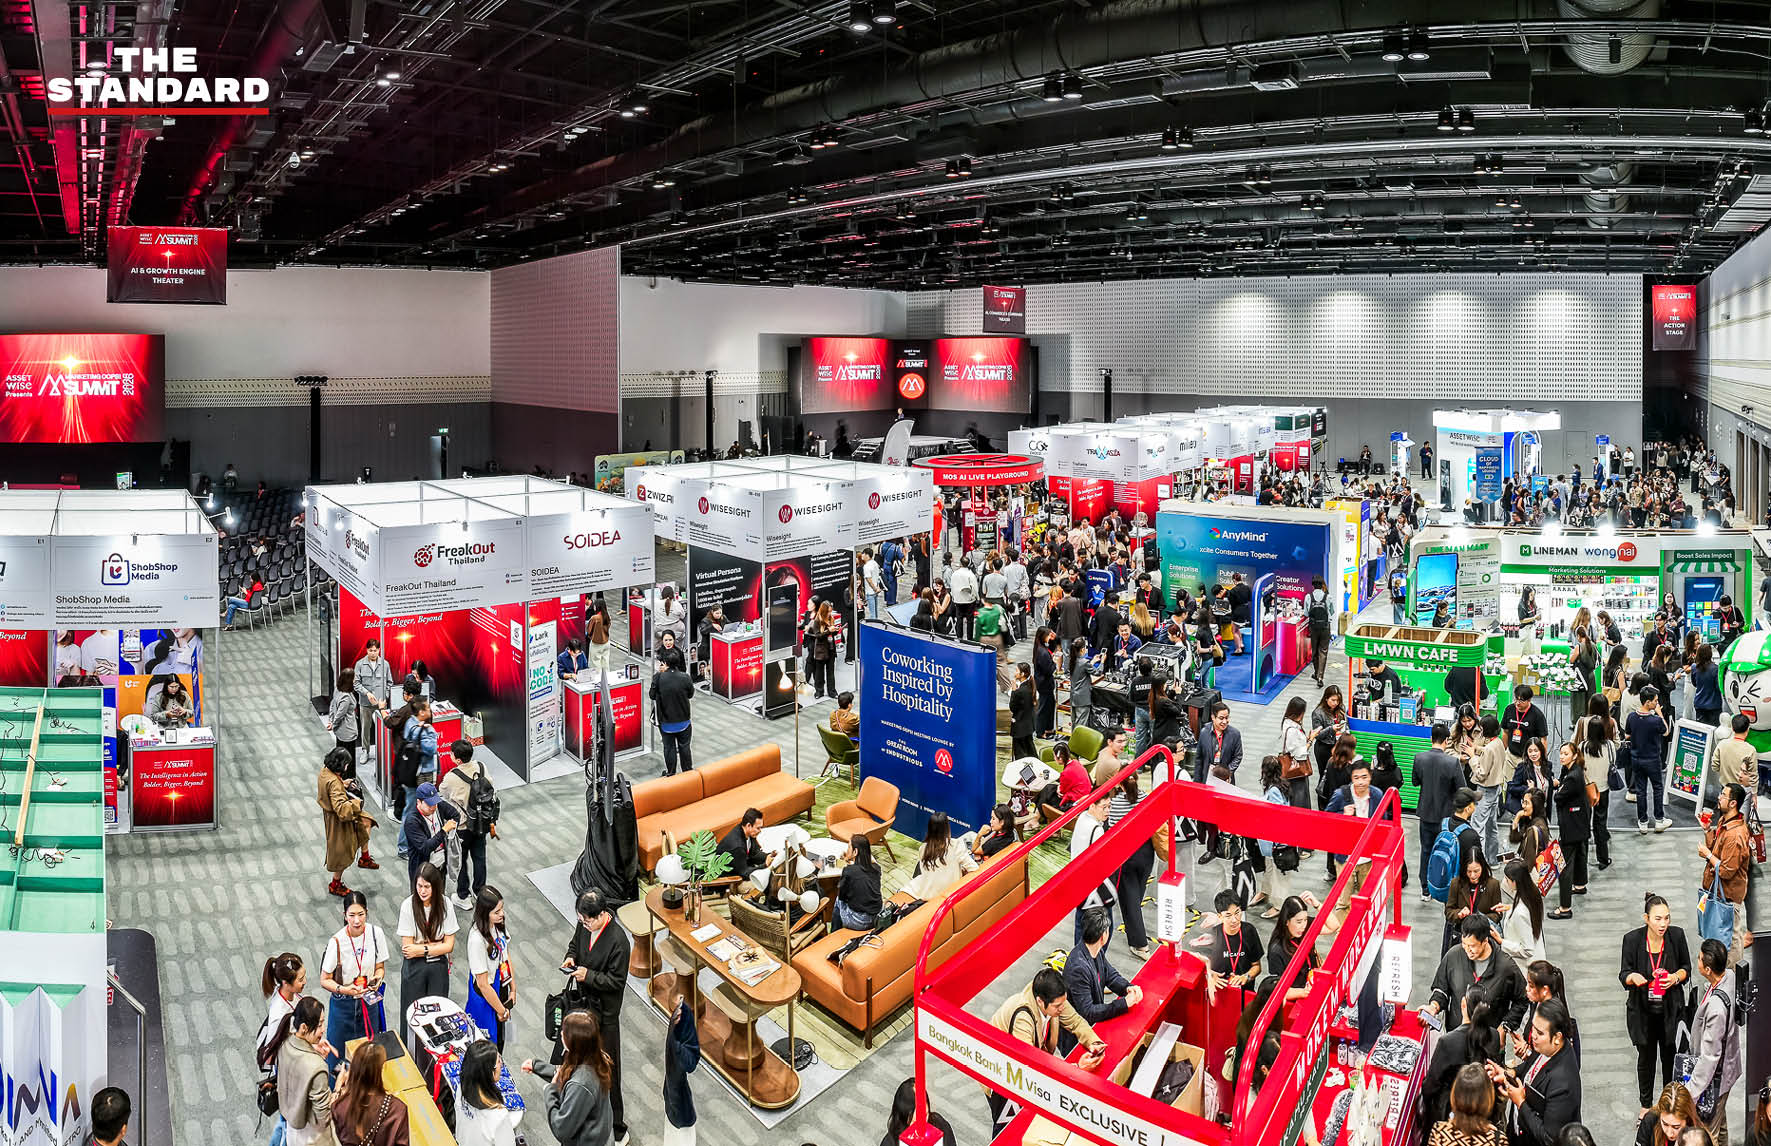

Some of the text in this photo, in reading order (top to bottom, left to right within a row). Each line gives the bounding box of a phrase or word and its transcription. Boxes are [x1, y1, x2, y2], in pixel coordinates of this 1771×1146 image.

[146, 267, 178, 275] GROWTH
[987, 471, 1029, 480] PLAYGROUND
[881, 490, 923, 503] WISESIGHT
[710, 502, 751, 518] WISESIGHT
[795, 502, 843, 516] WISESIGHT
[858, 518, 880, 526] Wisesight
[563, 530, 621, 551] SOIDEA
[767, 533, 791, 542] Wisesight
[437, 542, 496, 558] FreakOut
[1215, 547, 1249, 558] Consumers
[1251, 551, 1278, 560] Together
[448, 555, 485, 566] Thailand
[131, 562, 178, 572] ShobShop
[531, 566, 560, 577] SOIDEA
[1169, 564, 1199, 573] Enterprise
[131, 572, 160, 581] Media
[695, 567, 741, 580] Virtual Persona
[1276, 575, 1300, 584] Creator
[386, 579, 457, 593] FreakOut Thailand
[1276, 583, 1304, 593] Solutions
[56, 595, 130, 605] ShobShop Media
[417, 614, 443, 624] Beyond
[535, 630, 548, 641] Lark
[1364, 642, 1458, 662] LMWN CAFE
[882, 647, 953, 684] Coworking
[533, 666, 545, 679] NO
[882, 665, 953, 702] Inspired by
[882, 684, 953, 722] Hospitality
[151, 772, 181, 780] Intelligence
[184, 779, 203, 787] Beyond
[1165, 898, 1173, 937] REFRESH
[1391, 956, 1401, 997] REFRESH
[928, 1023, 973, 1060] Bangkok
[974, 1052, 1003, 1076] Bank
[1006, 1061, 1024, 1090] M
[1025, 1077, 1052, 1102] Visa
[1059, 1094, 1148, 1146] EXCLUSIVE
